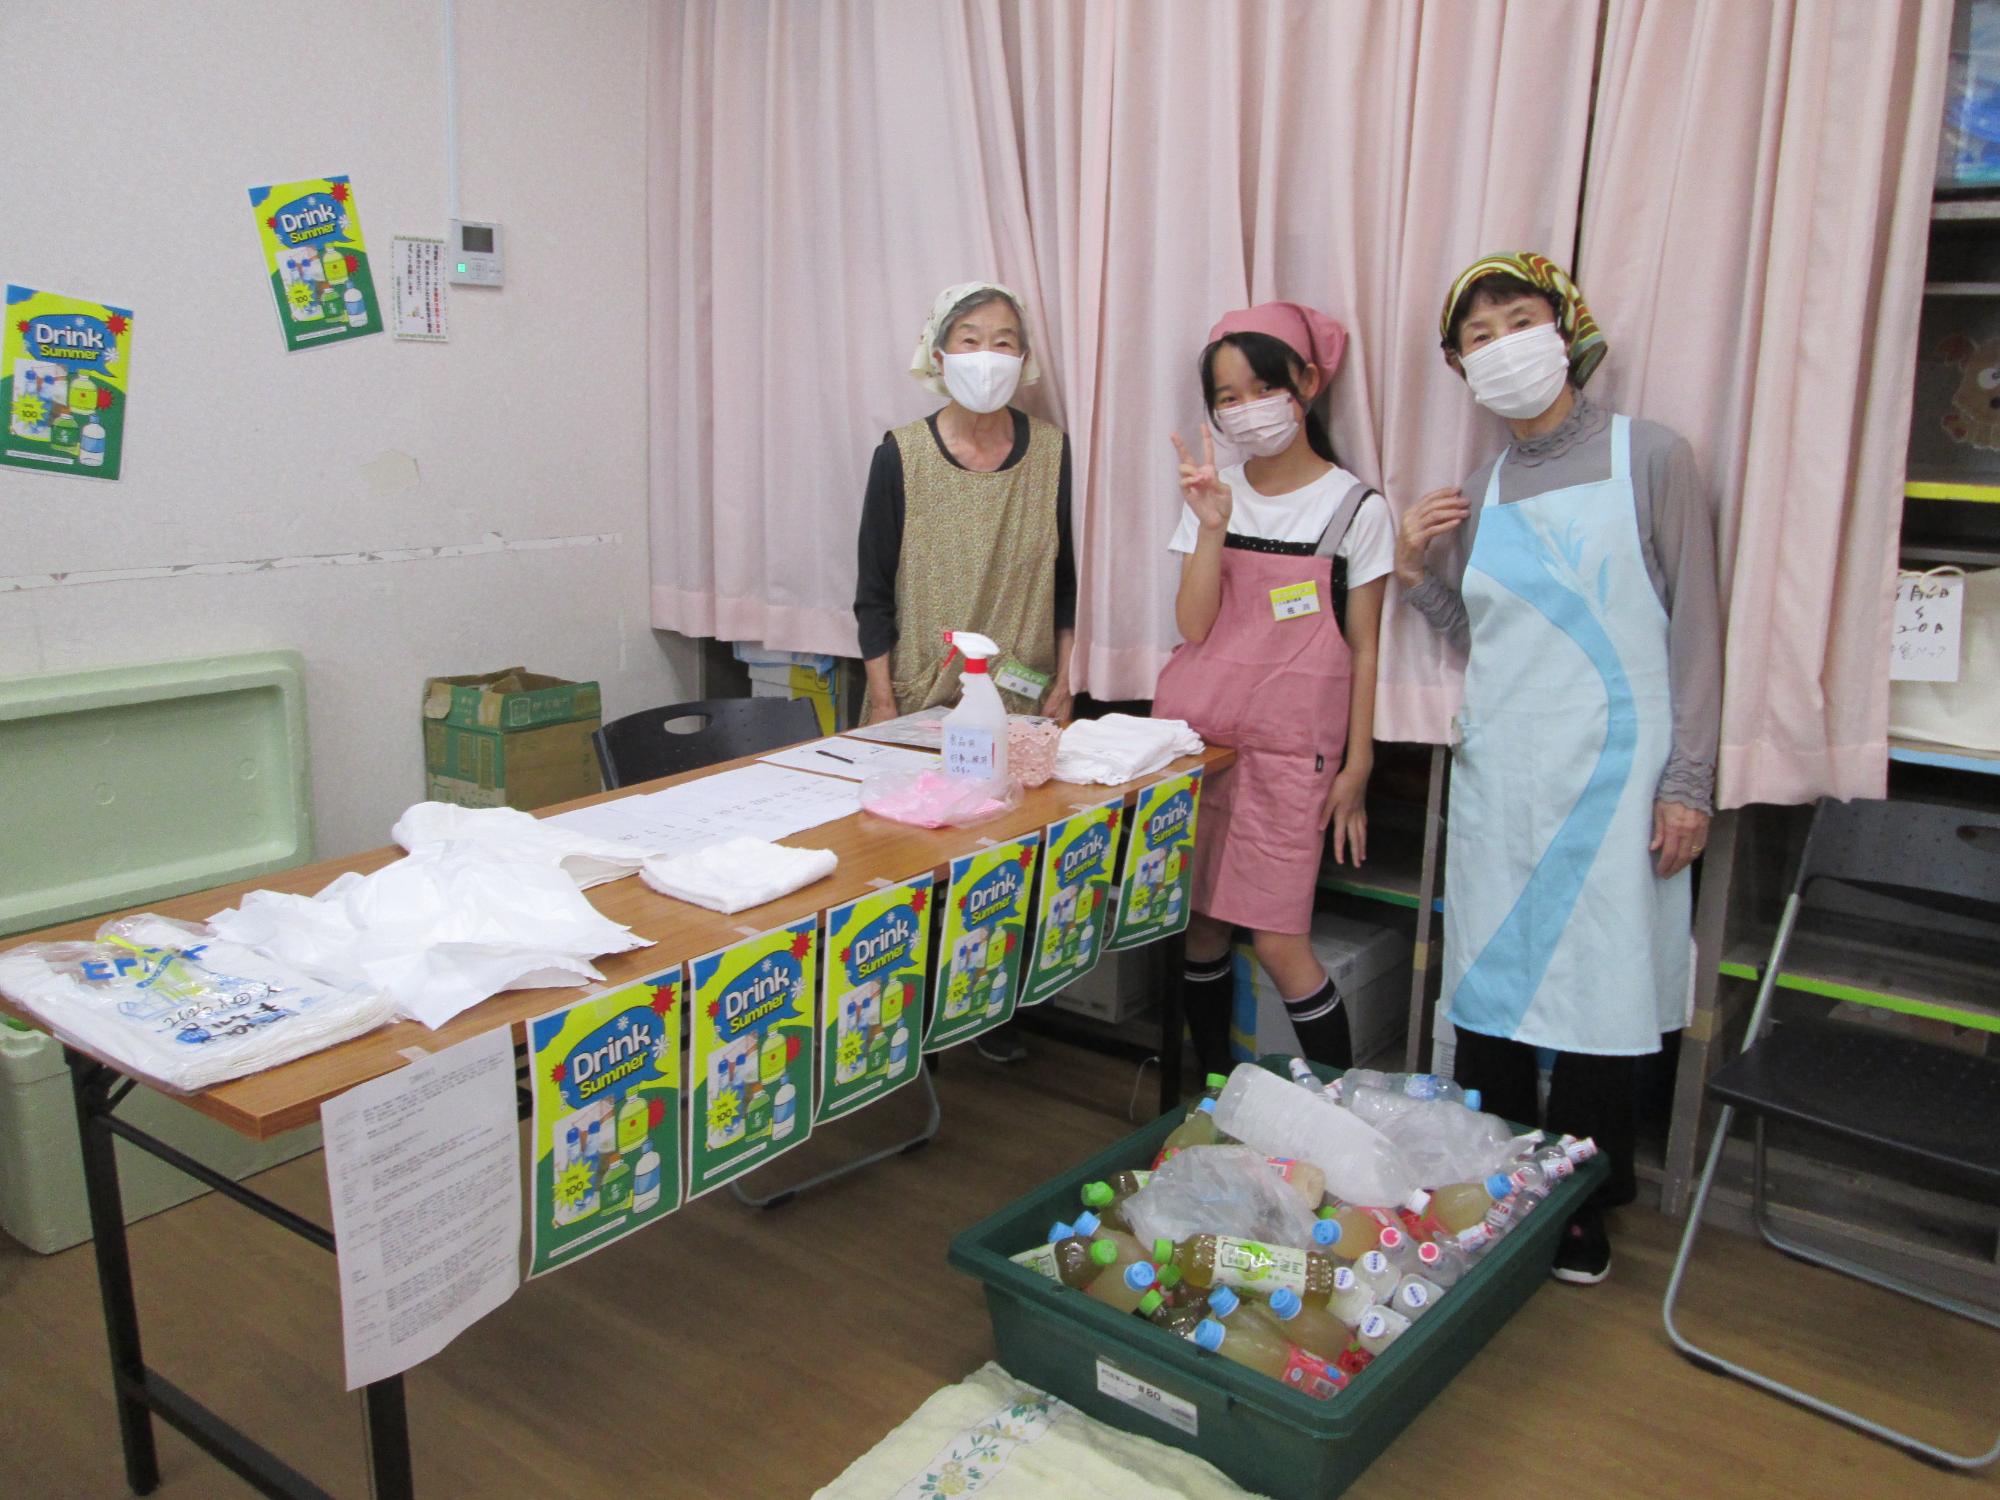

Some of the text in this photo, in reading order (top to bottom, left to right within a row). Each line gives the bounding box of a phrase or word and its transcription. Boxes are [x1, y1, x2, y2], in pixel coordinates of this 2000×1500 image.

[281, 203, 337, 233] Drink
[290, 222, 336, 244] Summer
[35, 323, 104, 349] Drink
[40, 344, 101, 361] Summer
[1152, 801, 1188, 835] Drink
[1152, 821, 1185, 845] Summer
[1063, 833, 1104, 872] Drink
[1064, 854, 1100, 883] Summer
[970, 873, 1016, 913] Drink
[971, 895, 1012, 926] Summer
[855, 919, 909, 966] Drink
[858, 942, 906, 980] Summer
[726, 966, 790, 1020] Drink
[730, 991, 787, 1035] Summer
[573, 1023, 650, 1084] Drink
[579, 1051, 648, 1101] Summer
[716, 1108, 732, 1121] 100
[566, 1181, 584, 1197] 100
